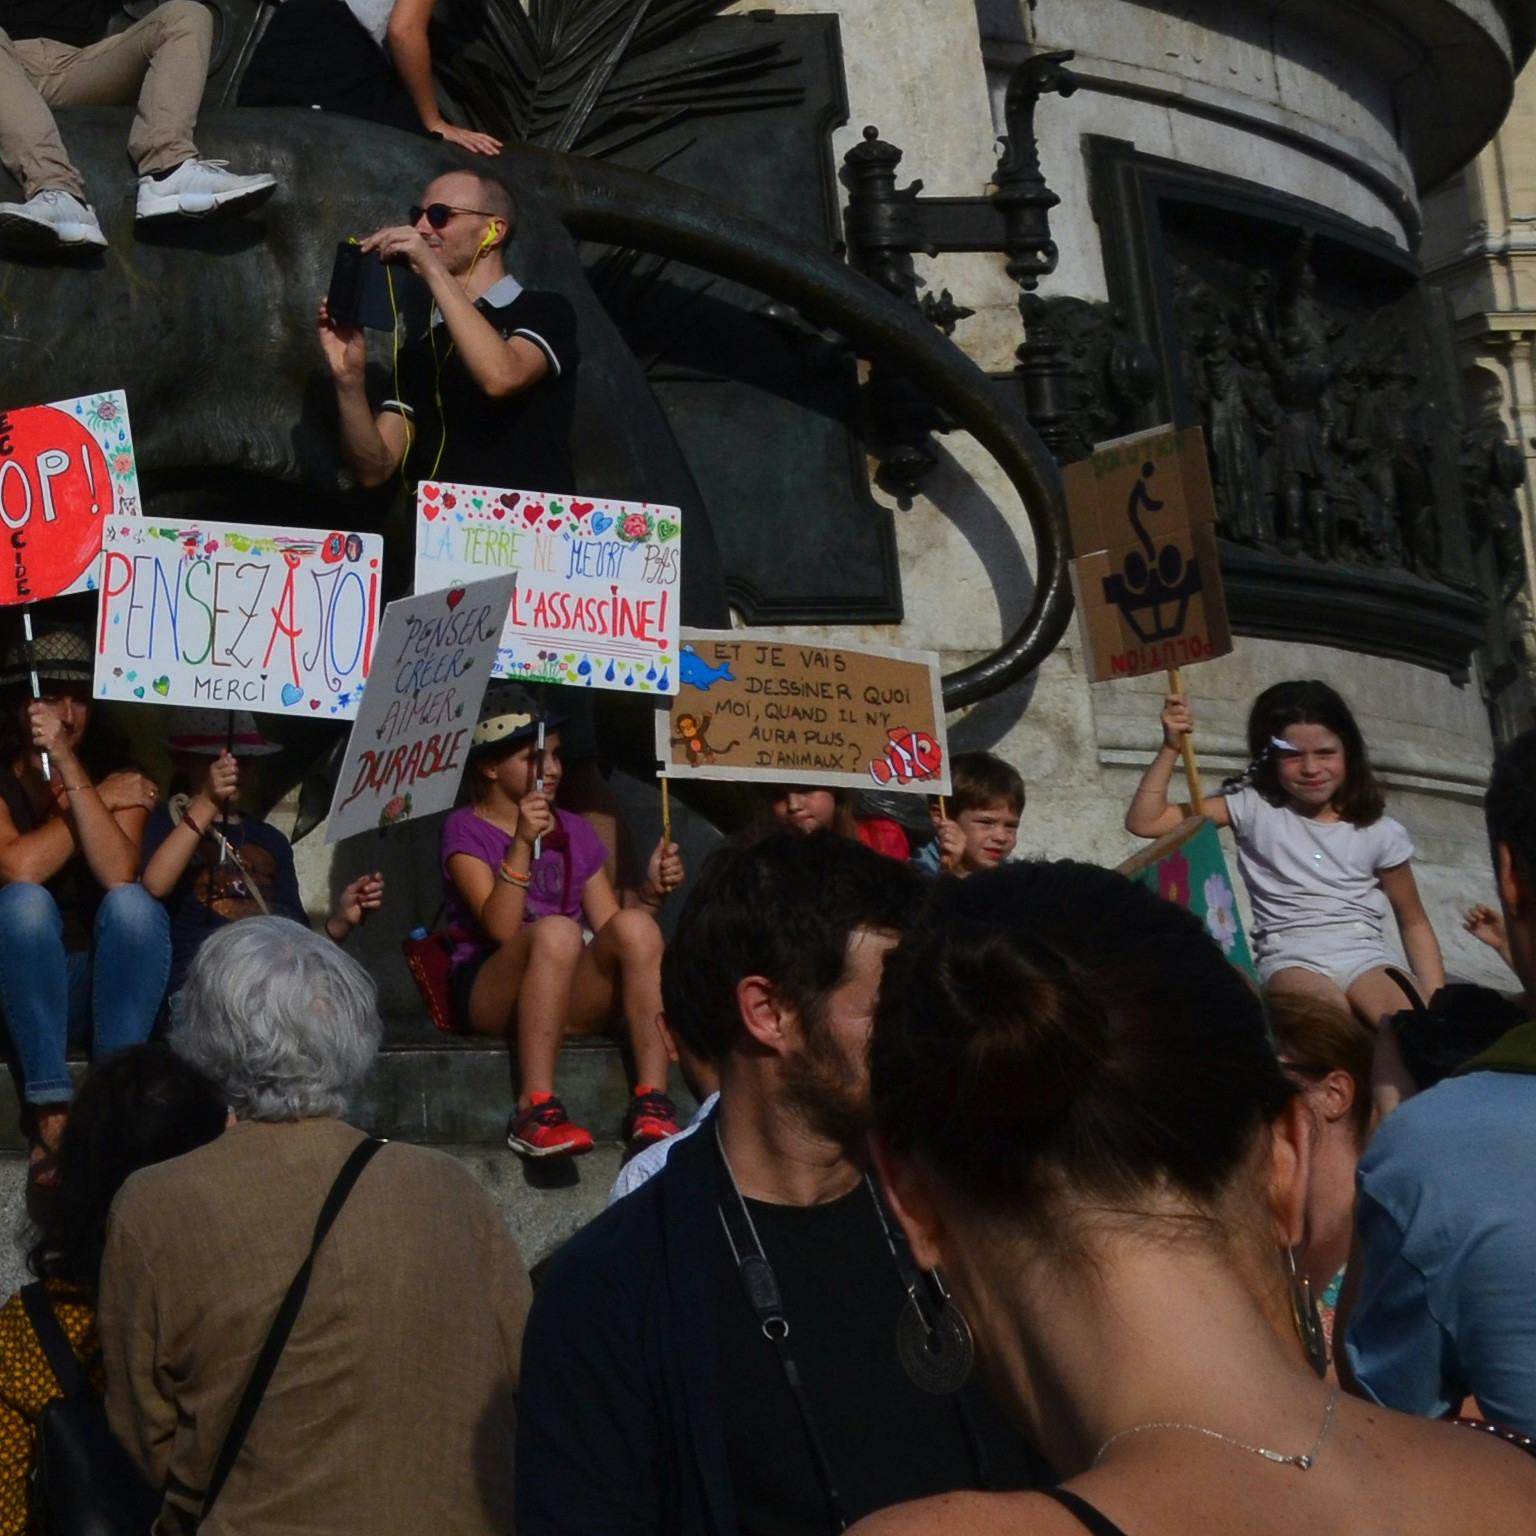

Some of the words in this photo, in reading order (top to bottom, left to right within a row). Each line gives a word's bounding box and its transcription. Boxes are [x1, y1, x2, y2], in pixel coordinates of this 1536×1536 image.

[421, 522, 455, 560] LA
[534, 533, 559, 573] NE
[641, 543, 680, 585] PAS
[99, 550, 272, 668] PENSEZ
[397, 604, 491, 664] PENSER
[714, 644, 741, 660] ET
[755, 646, 785, 666] JE
[387, 687, 457, 742] AIMER
[749, 726, 796, 743] AURA
[805, 729, 845, 747] PLUS
[765, 703, 828, 724] QUAND
[839, 709, 857, 724] IL
[866, 711, 891, 727] N'Y
[340, 728, 469, 810] DURABLE
